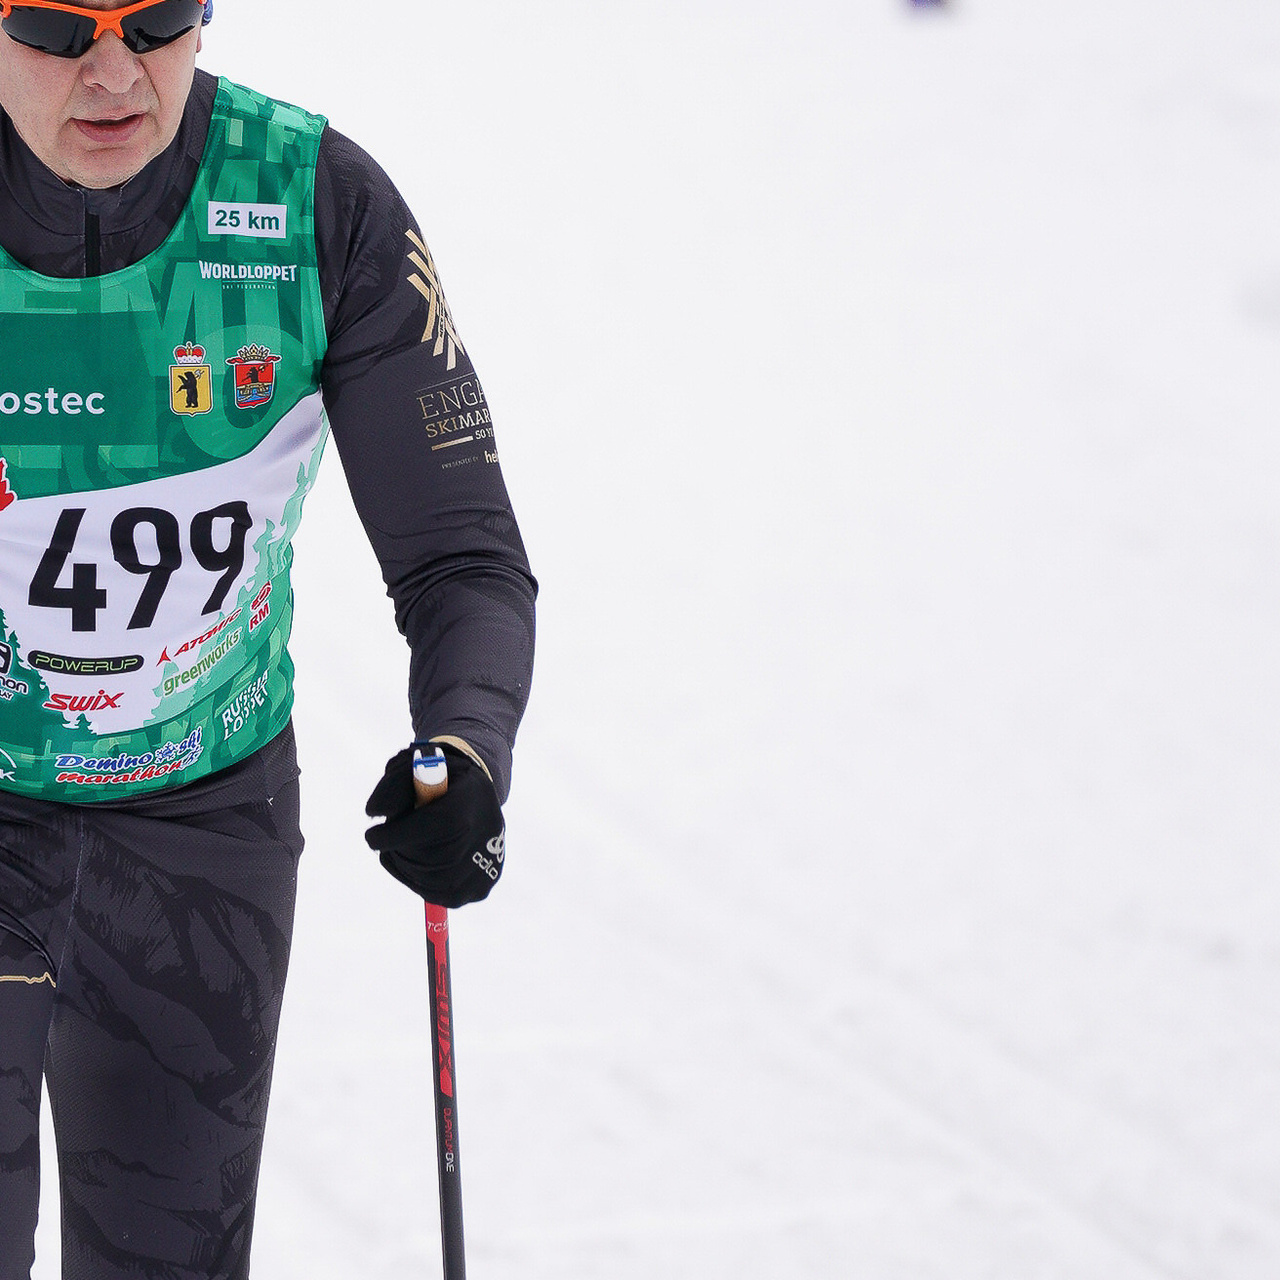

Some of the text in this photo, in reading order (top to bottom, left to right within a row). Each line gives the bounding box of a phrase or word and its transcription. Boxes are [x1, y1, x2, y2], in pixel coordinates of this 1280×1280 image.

[215, 210, 280, 230] 25 km
[199, 260, 298, 282] WORLDLOPPET
[28, 501, 253, 632] 499
[174, 608, 242, 658] ATOMIC
[249, 602, 270, 631] RM
[35, 653, 139, 673] POWERUP
[163, 629, 241, 697] greenworks
[222, 669, 269, 729] RUSSIA
[223, 679, 269, 741] LOPPET
[56, 726, 202, 771] Demino ski
[55, 760, 182, 786] marathon
[472, 850, 499, 881] odlo
